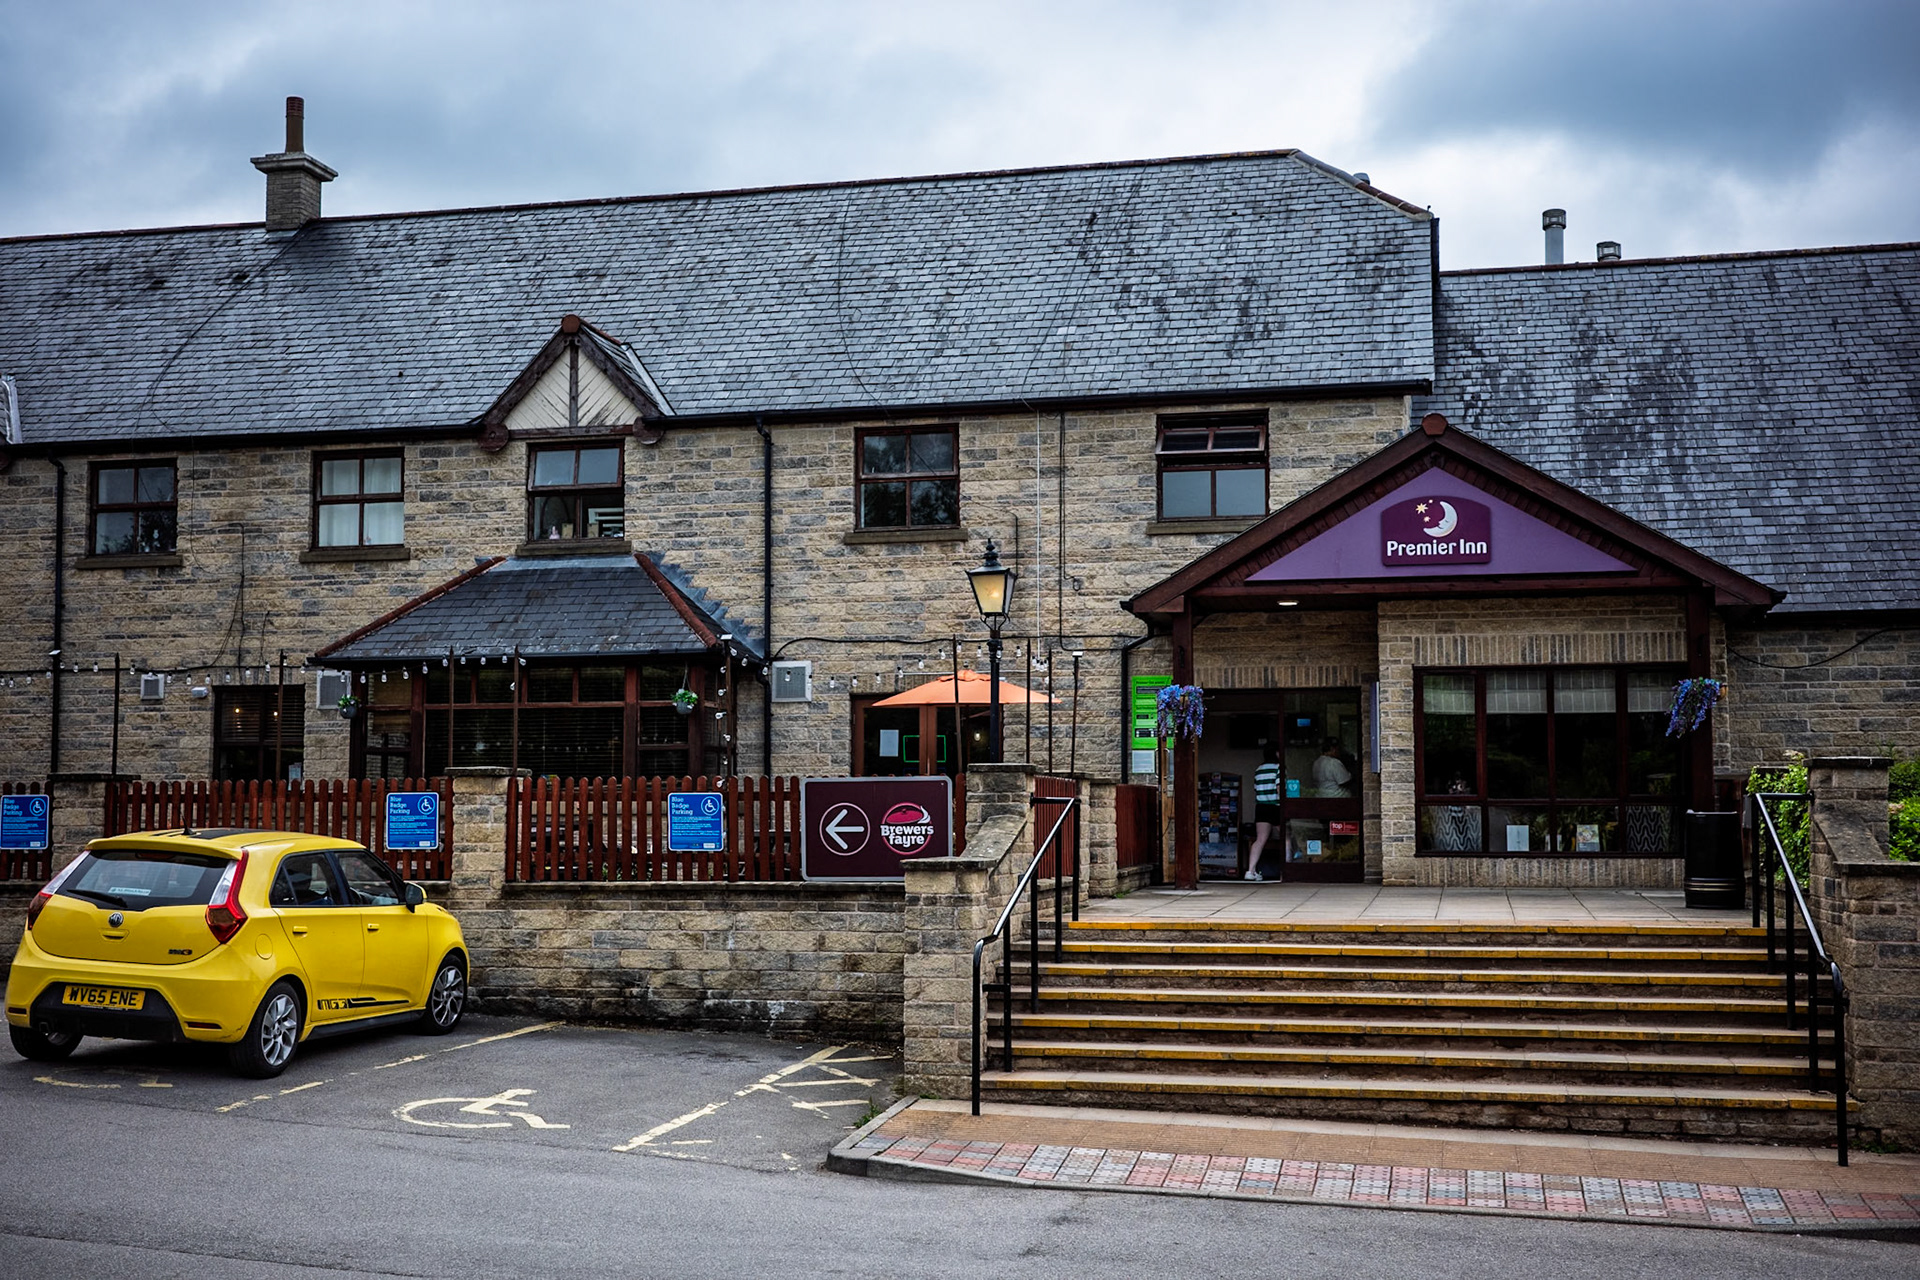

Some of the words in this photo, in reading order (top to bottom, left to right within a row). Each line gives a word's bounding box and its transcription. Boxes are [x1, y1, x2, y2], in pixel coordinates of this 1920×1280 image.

[1387, 540, 1457, 556] Premier
[1460, 539, 1487, 554] Inn
[880, 825, 934, 836] Brewers
[889, 833, 925, 848] fayre
[69, 987, 107, 1003] WV65
[109, 991, 139, 1006] ENE
